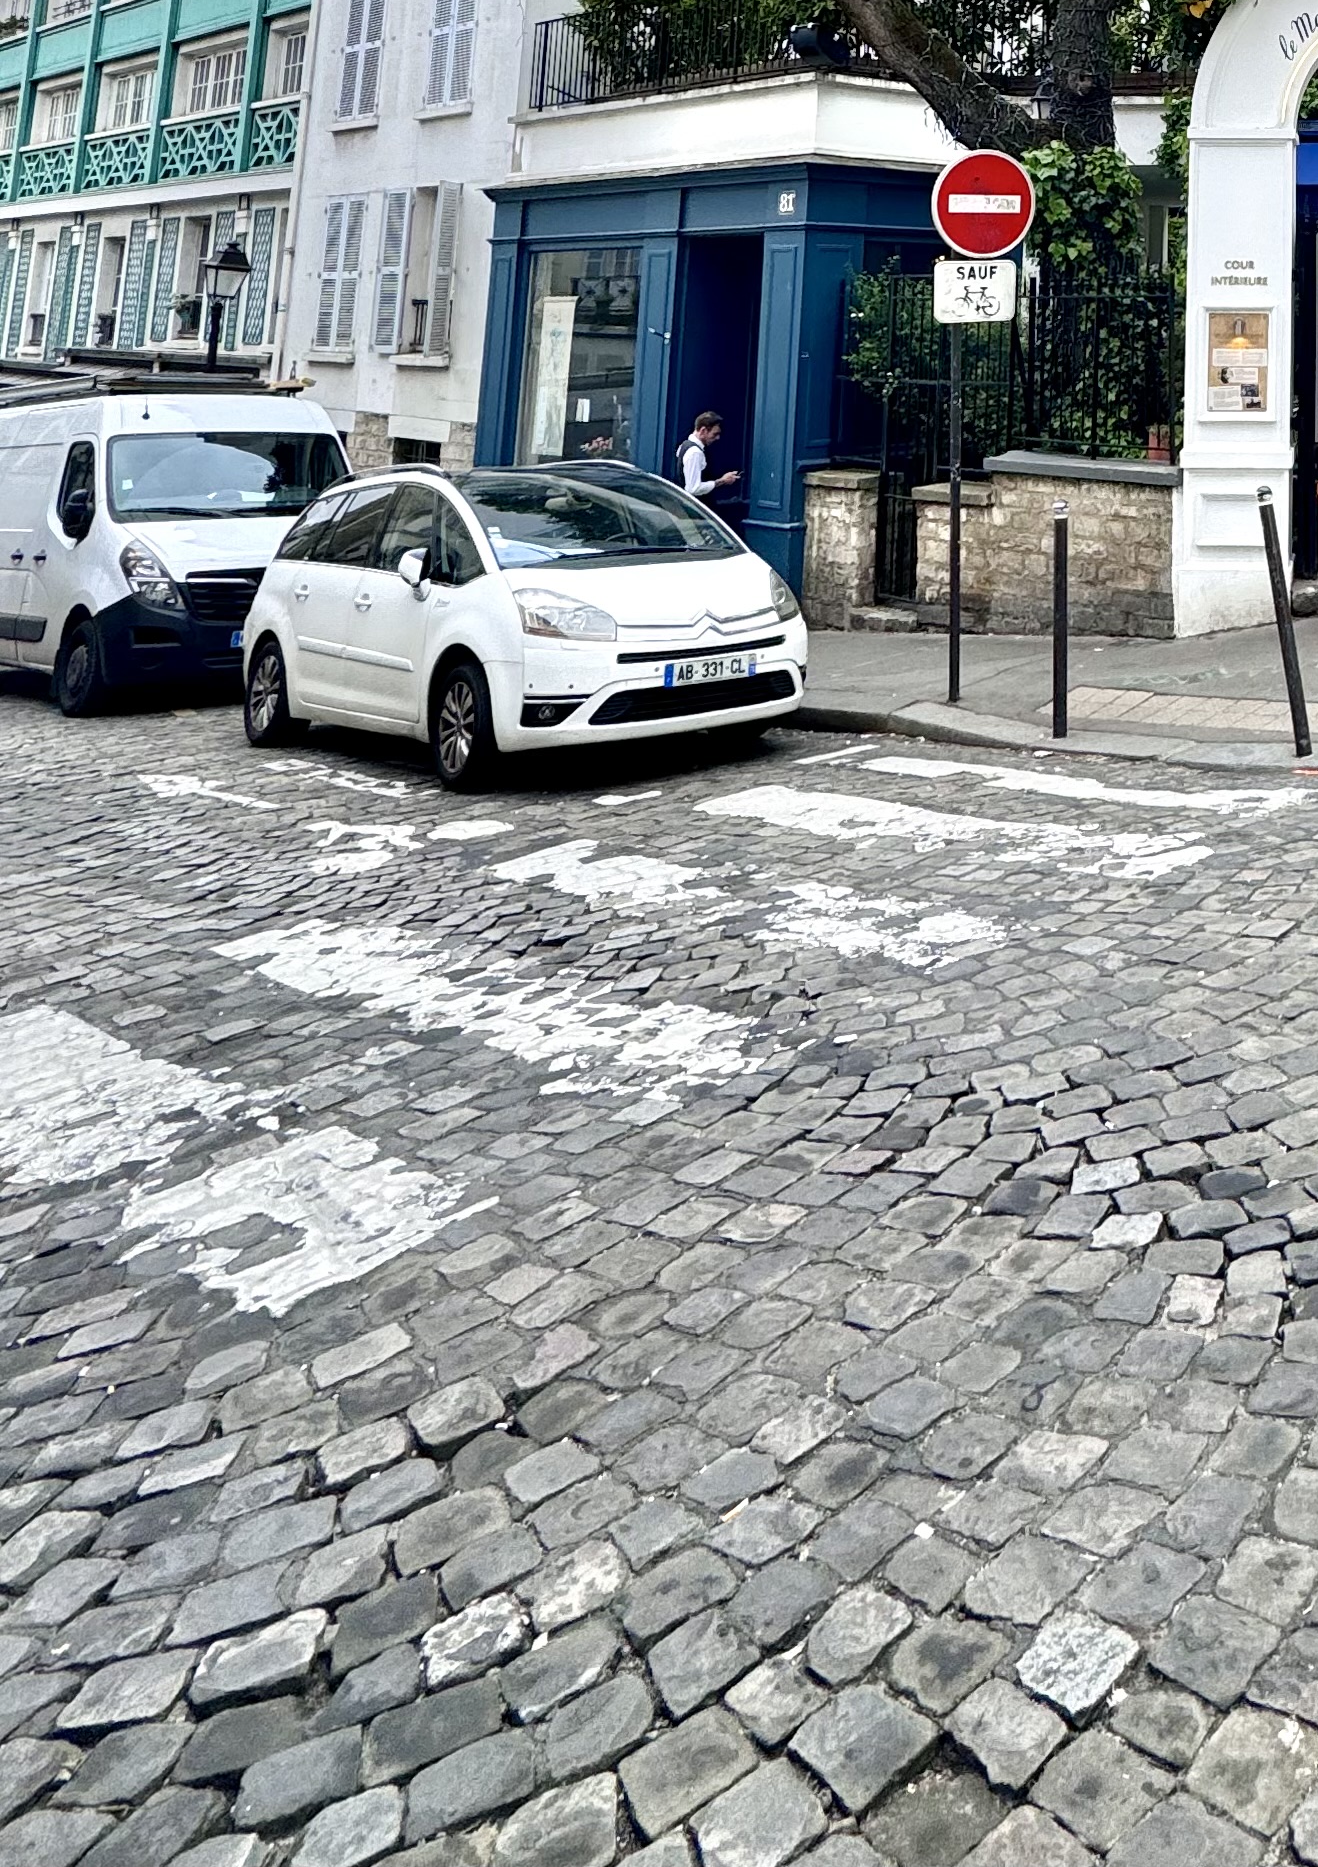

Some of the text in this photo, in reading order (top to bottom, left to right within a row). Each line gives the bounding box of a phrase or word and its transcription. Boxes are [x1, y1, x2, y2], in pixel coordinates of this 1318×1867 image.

[1278, 34, 1298, 61] le
[956, 265, 998, 281] SAUF
[1224, 260, 1255, 270] COUR
